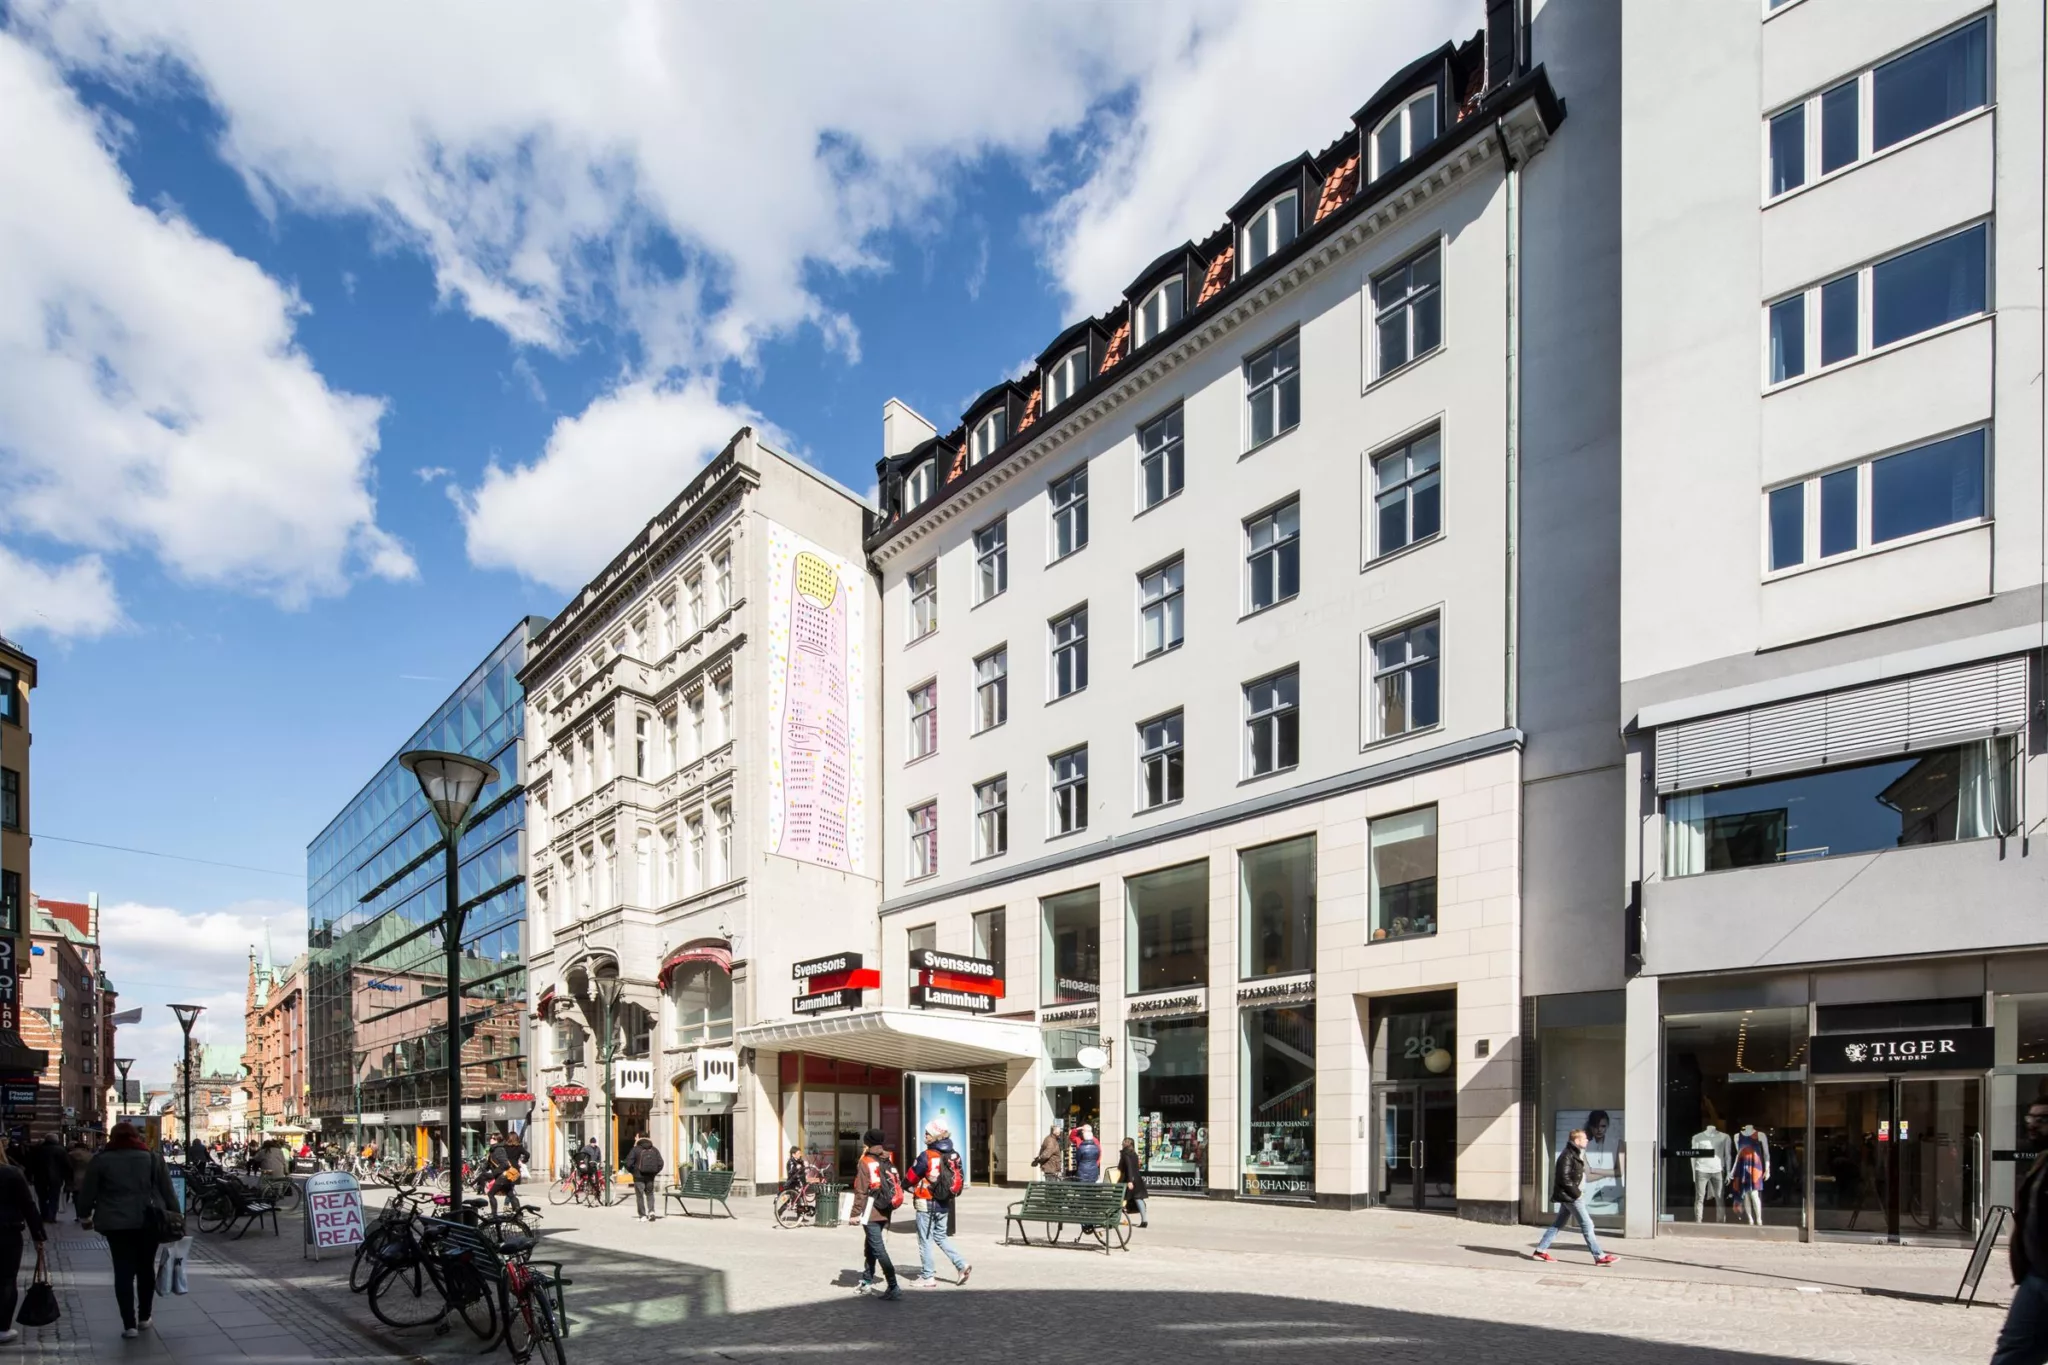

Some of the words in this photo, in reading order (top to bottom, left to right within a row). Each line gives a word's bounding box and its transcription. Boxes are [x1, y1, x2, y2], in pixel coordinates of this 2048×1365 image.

[794, 957, 847, 978] Svenssons
[925, 952, 994, 976] Svenssons
[929, 970, 935, 985] i
[794, 990, 842, 1012] Lammhult
[925, 988, 989, 1010] Lammhult
[1404, 1035, 1436, 1059] 28
[1871, 1040, 1956, 1055] TIGER
[1245, 1179, 1313, 1191] BOKHANDEL
[313, 1192, 358, 1210] REA
[315, 1210, 360, 1228] REA
[318, 1228, 364, 1245] REA
